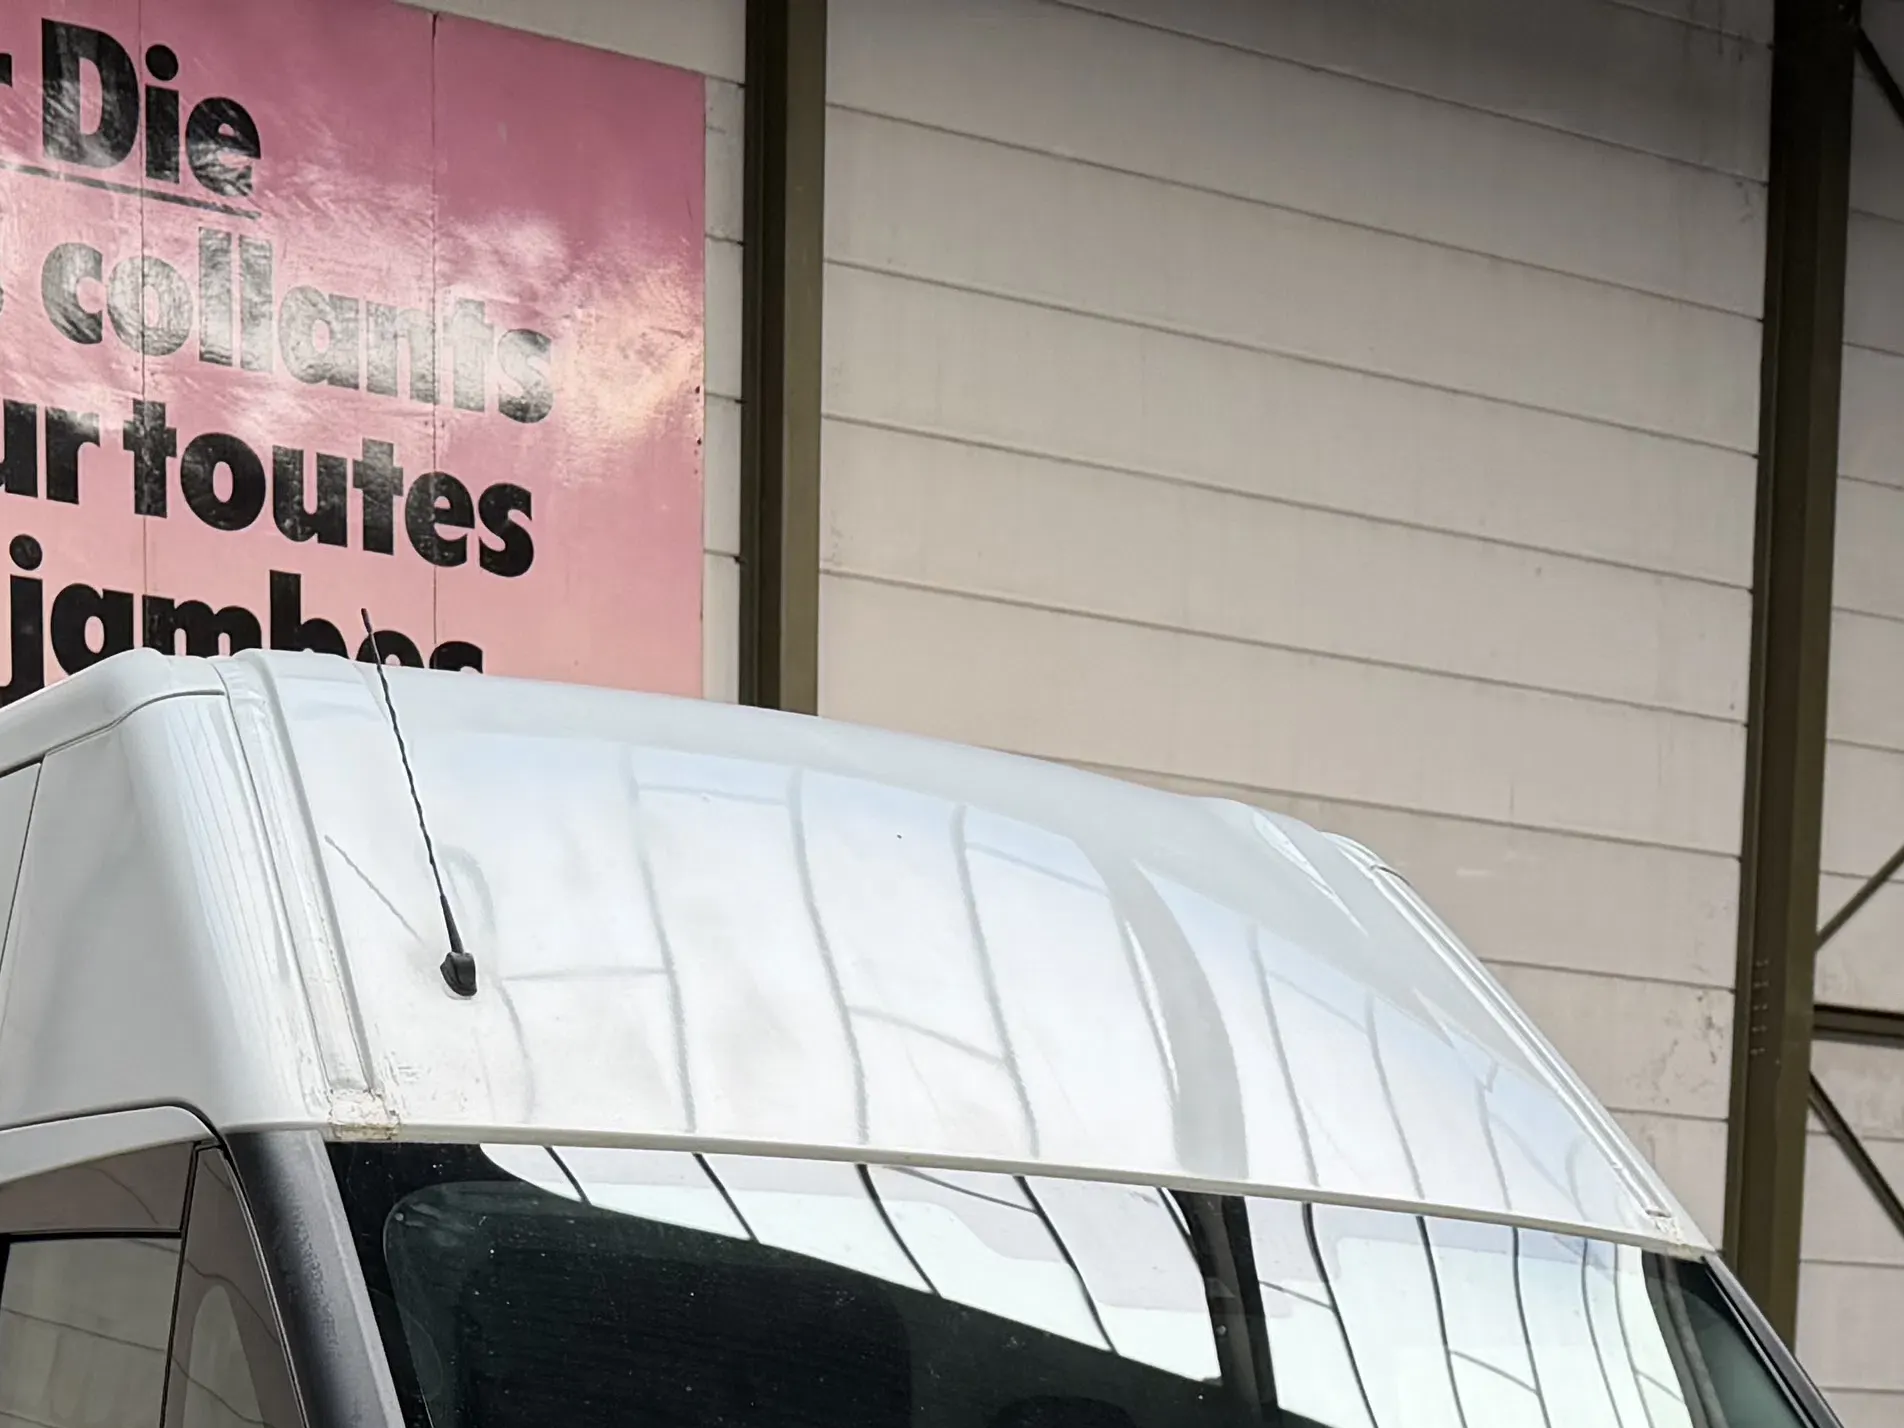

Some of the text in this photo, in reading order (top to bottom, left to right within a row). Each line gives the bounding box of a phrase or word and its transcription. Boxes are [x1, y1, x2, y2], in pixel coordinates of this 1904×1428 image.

[41, 17, 261, 199] Die
[41, 225, 556, 424] collants
[121, 401, 536, 579] toutes
